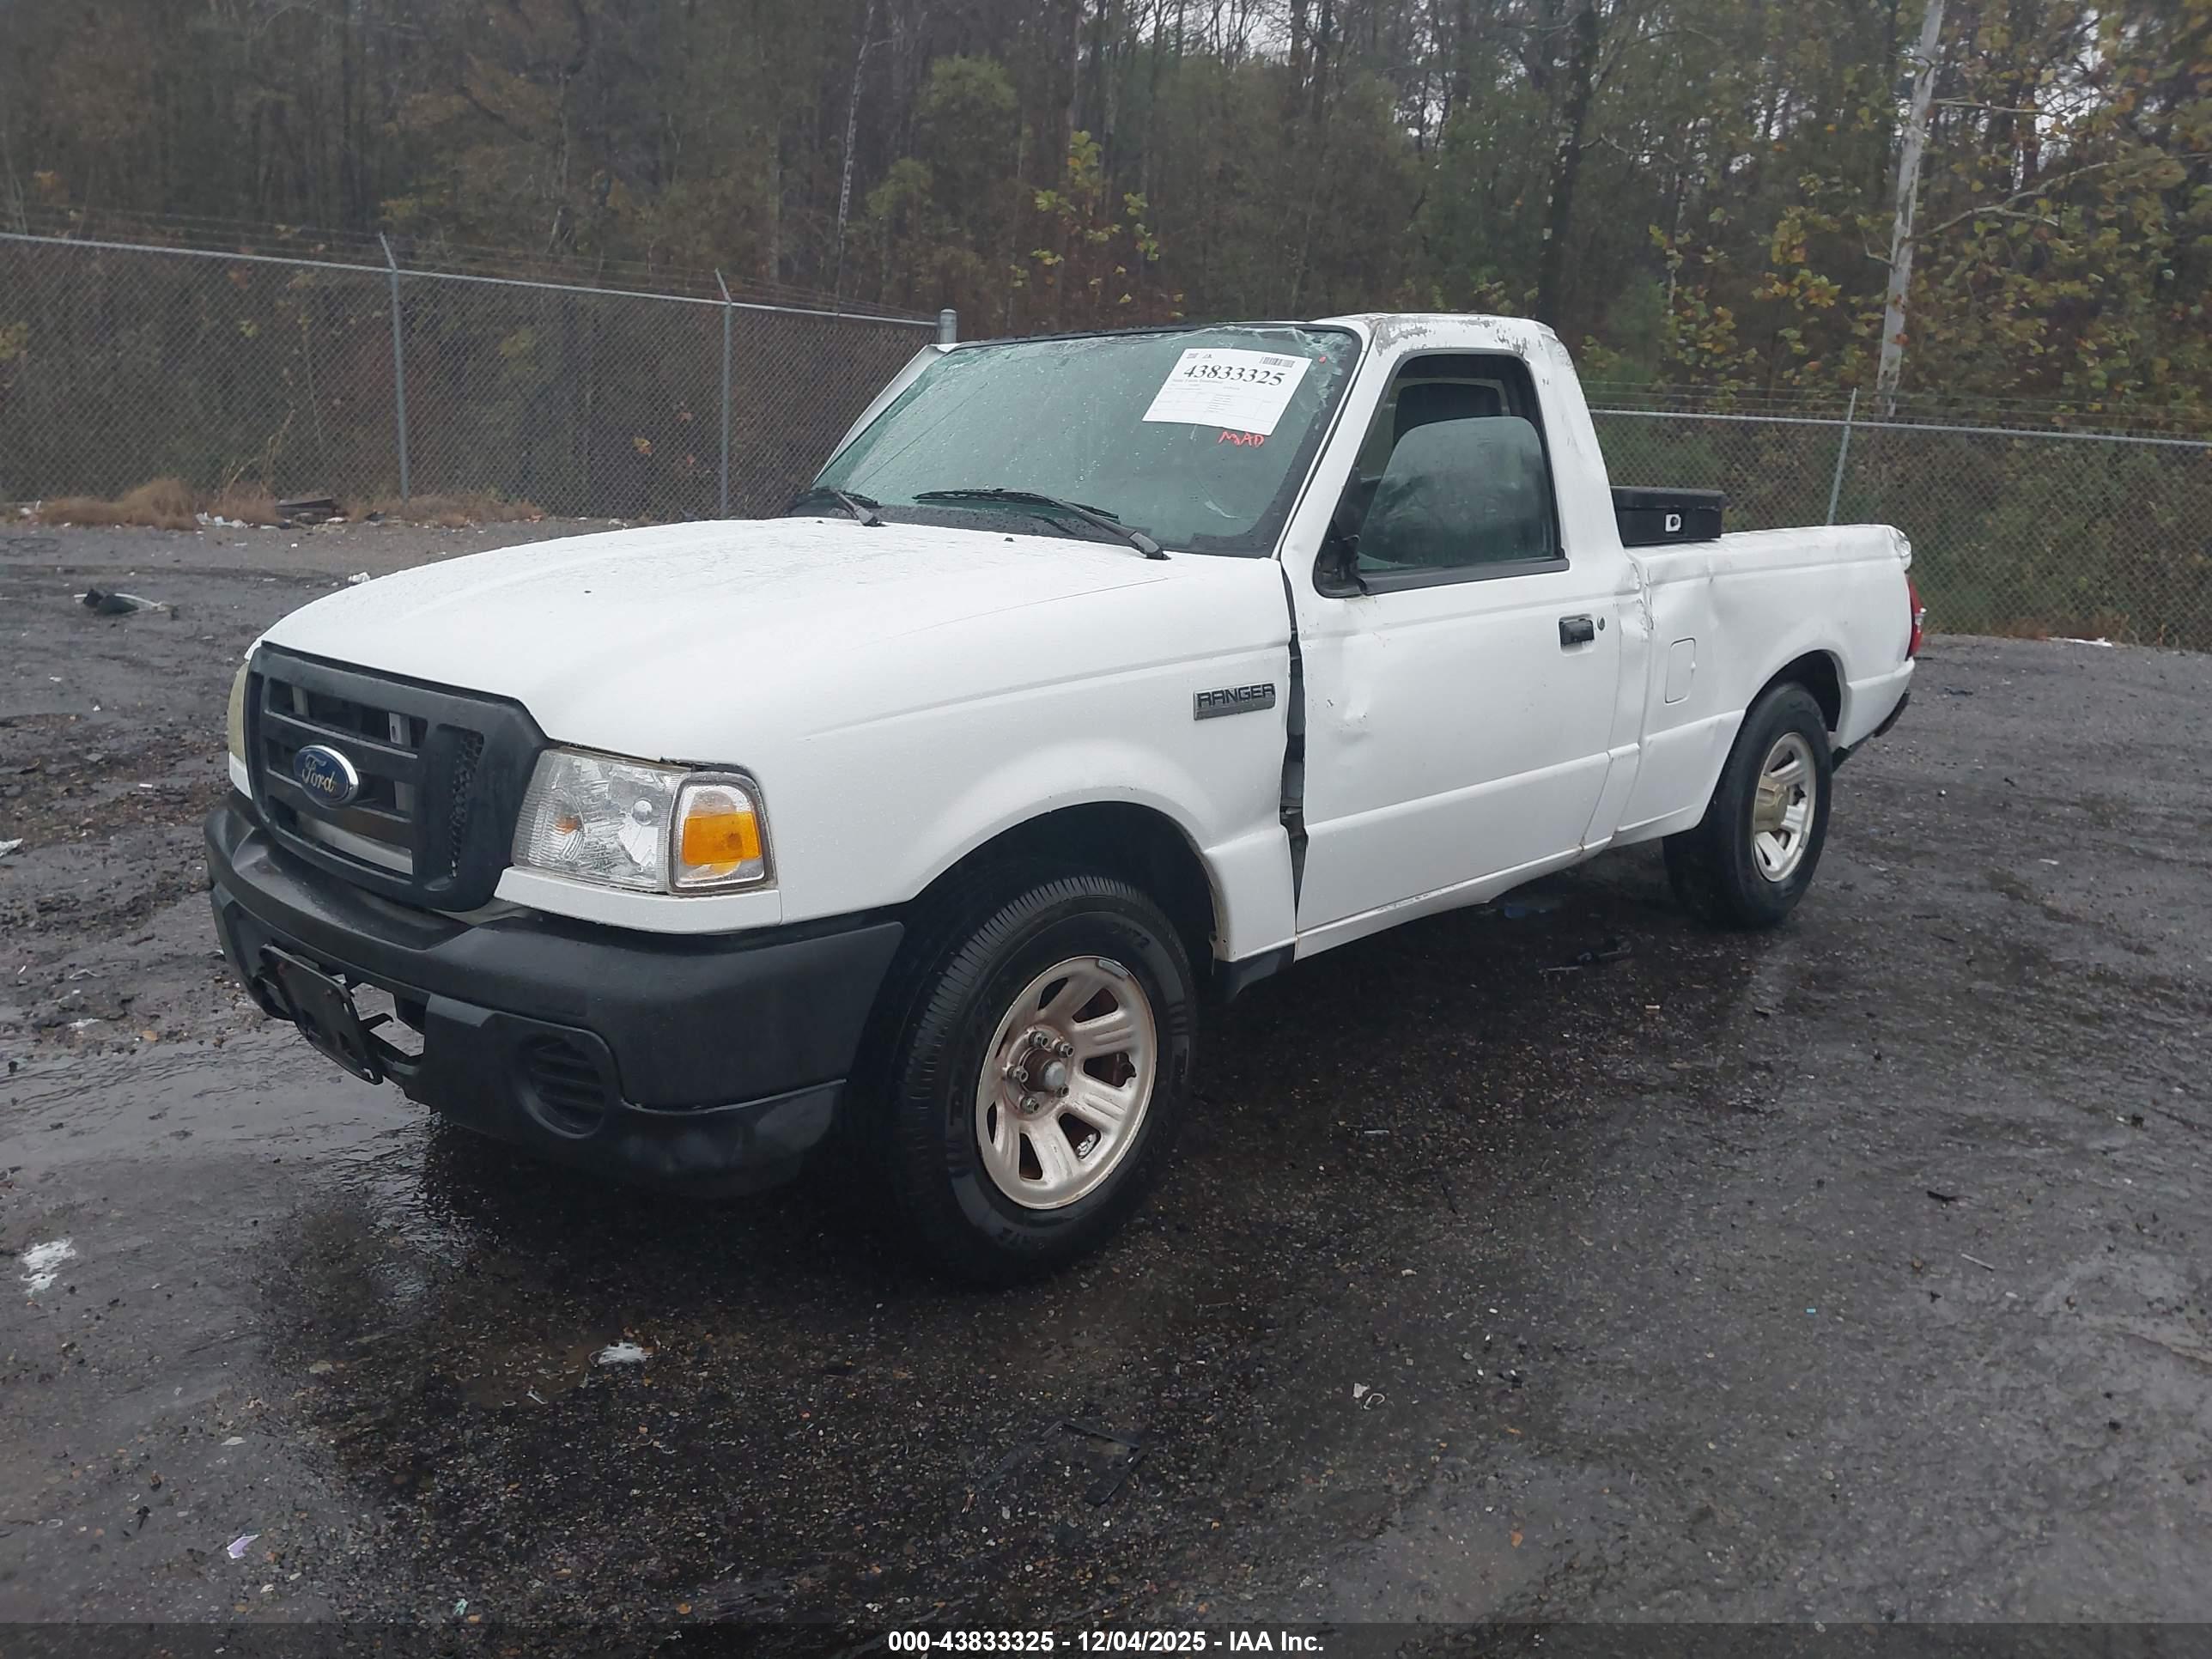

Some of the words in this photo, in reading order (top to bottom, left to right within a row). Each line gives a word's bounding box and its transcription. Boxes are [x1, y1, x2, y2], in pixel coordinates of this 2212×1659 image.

[1183, 364, 1285, 386] 43833325
[1197, 684, 1275, 708] RANGER
[301, 754, 336, 793] Ford
